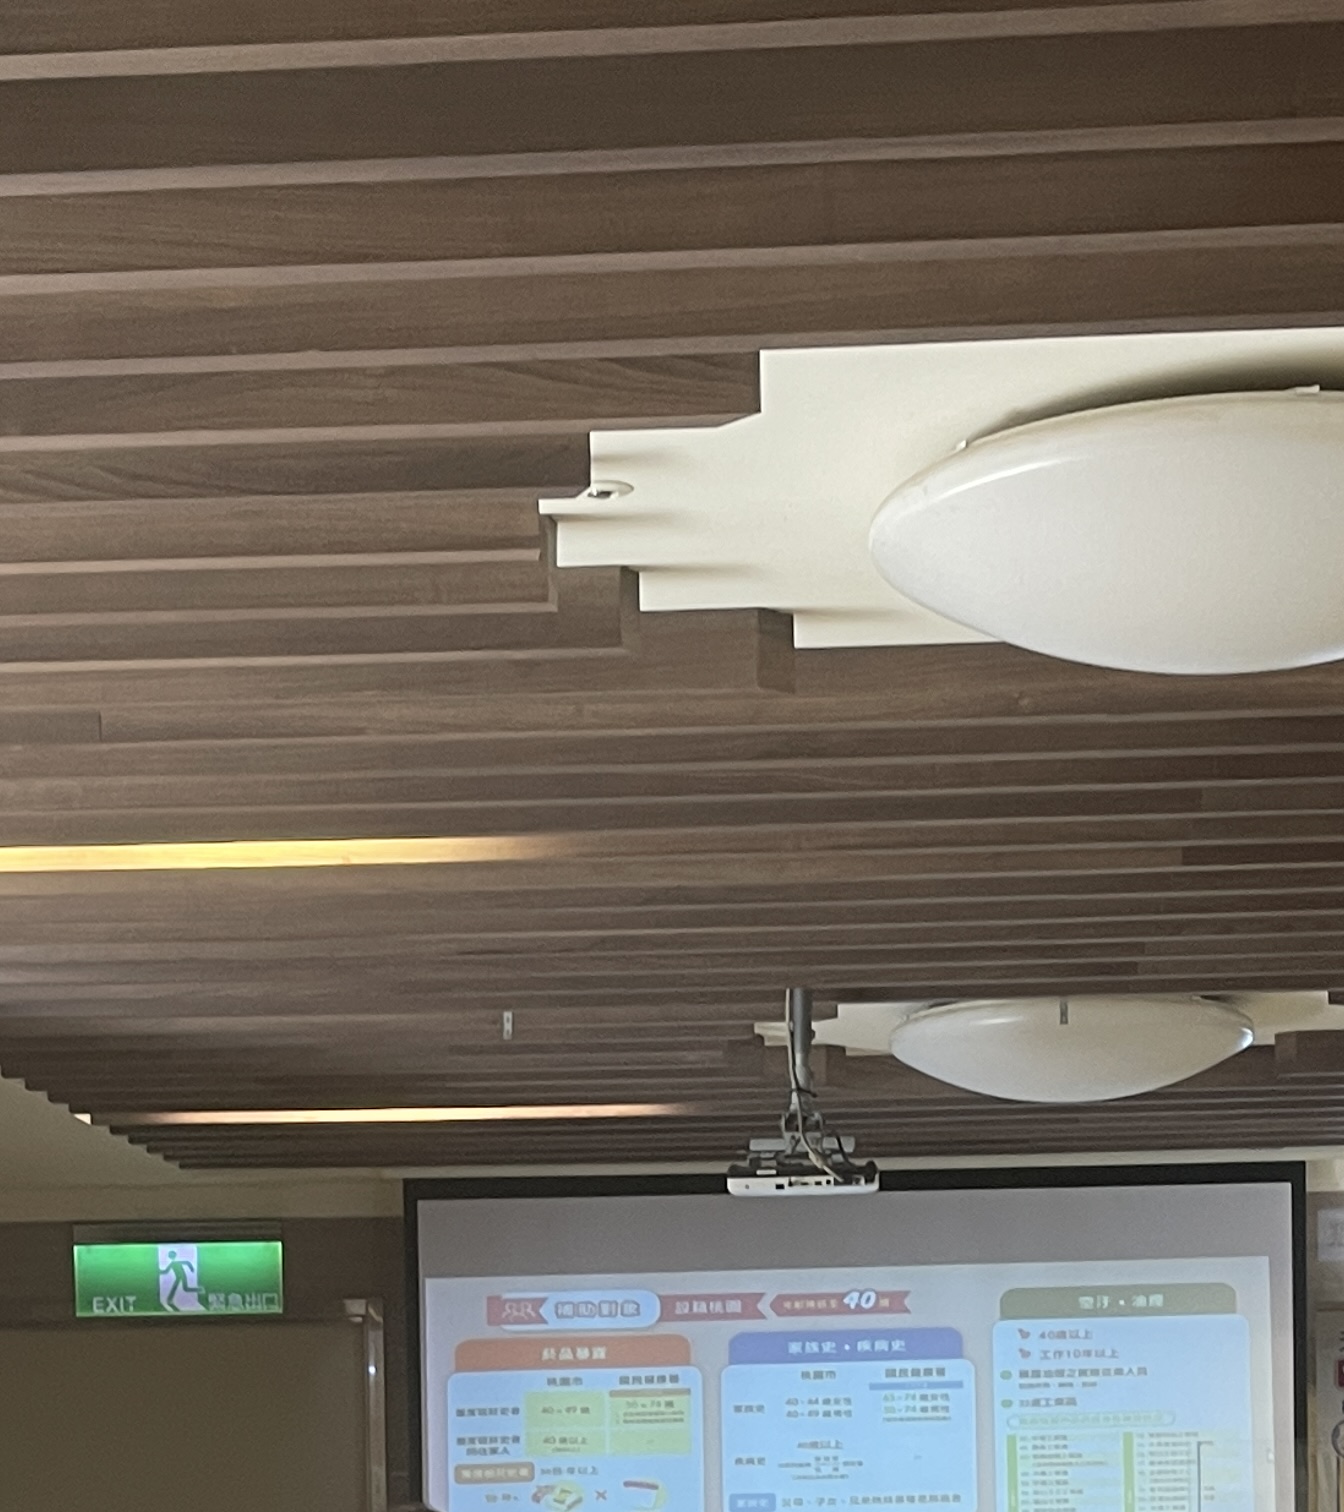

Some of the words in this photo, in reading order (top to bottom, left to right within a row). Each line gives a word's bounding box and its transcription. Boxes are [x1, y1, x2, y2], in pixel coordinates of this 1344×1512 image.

[92, 1295, 137, 1314] EXIT
[207, 1292, 279, 1312] 緊急出口
[843, 1290, 877, 1310] 40
